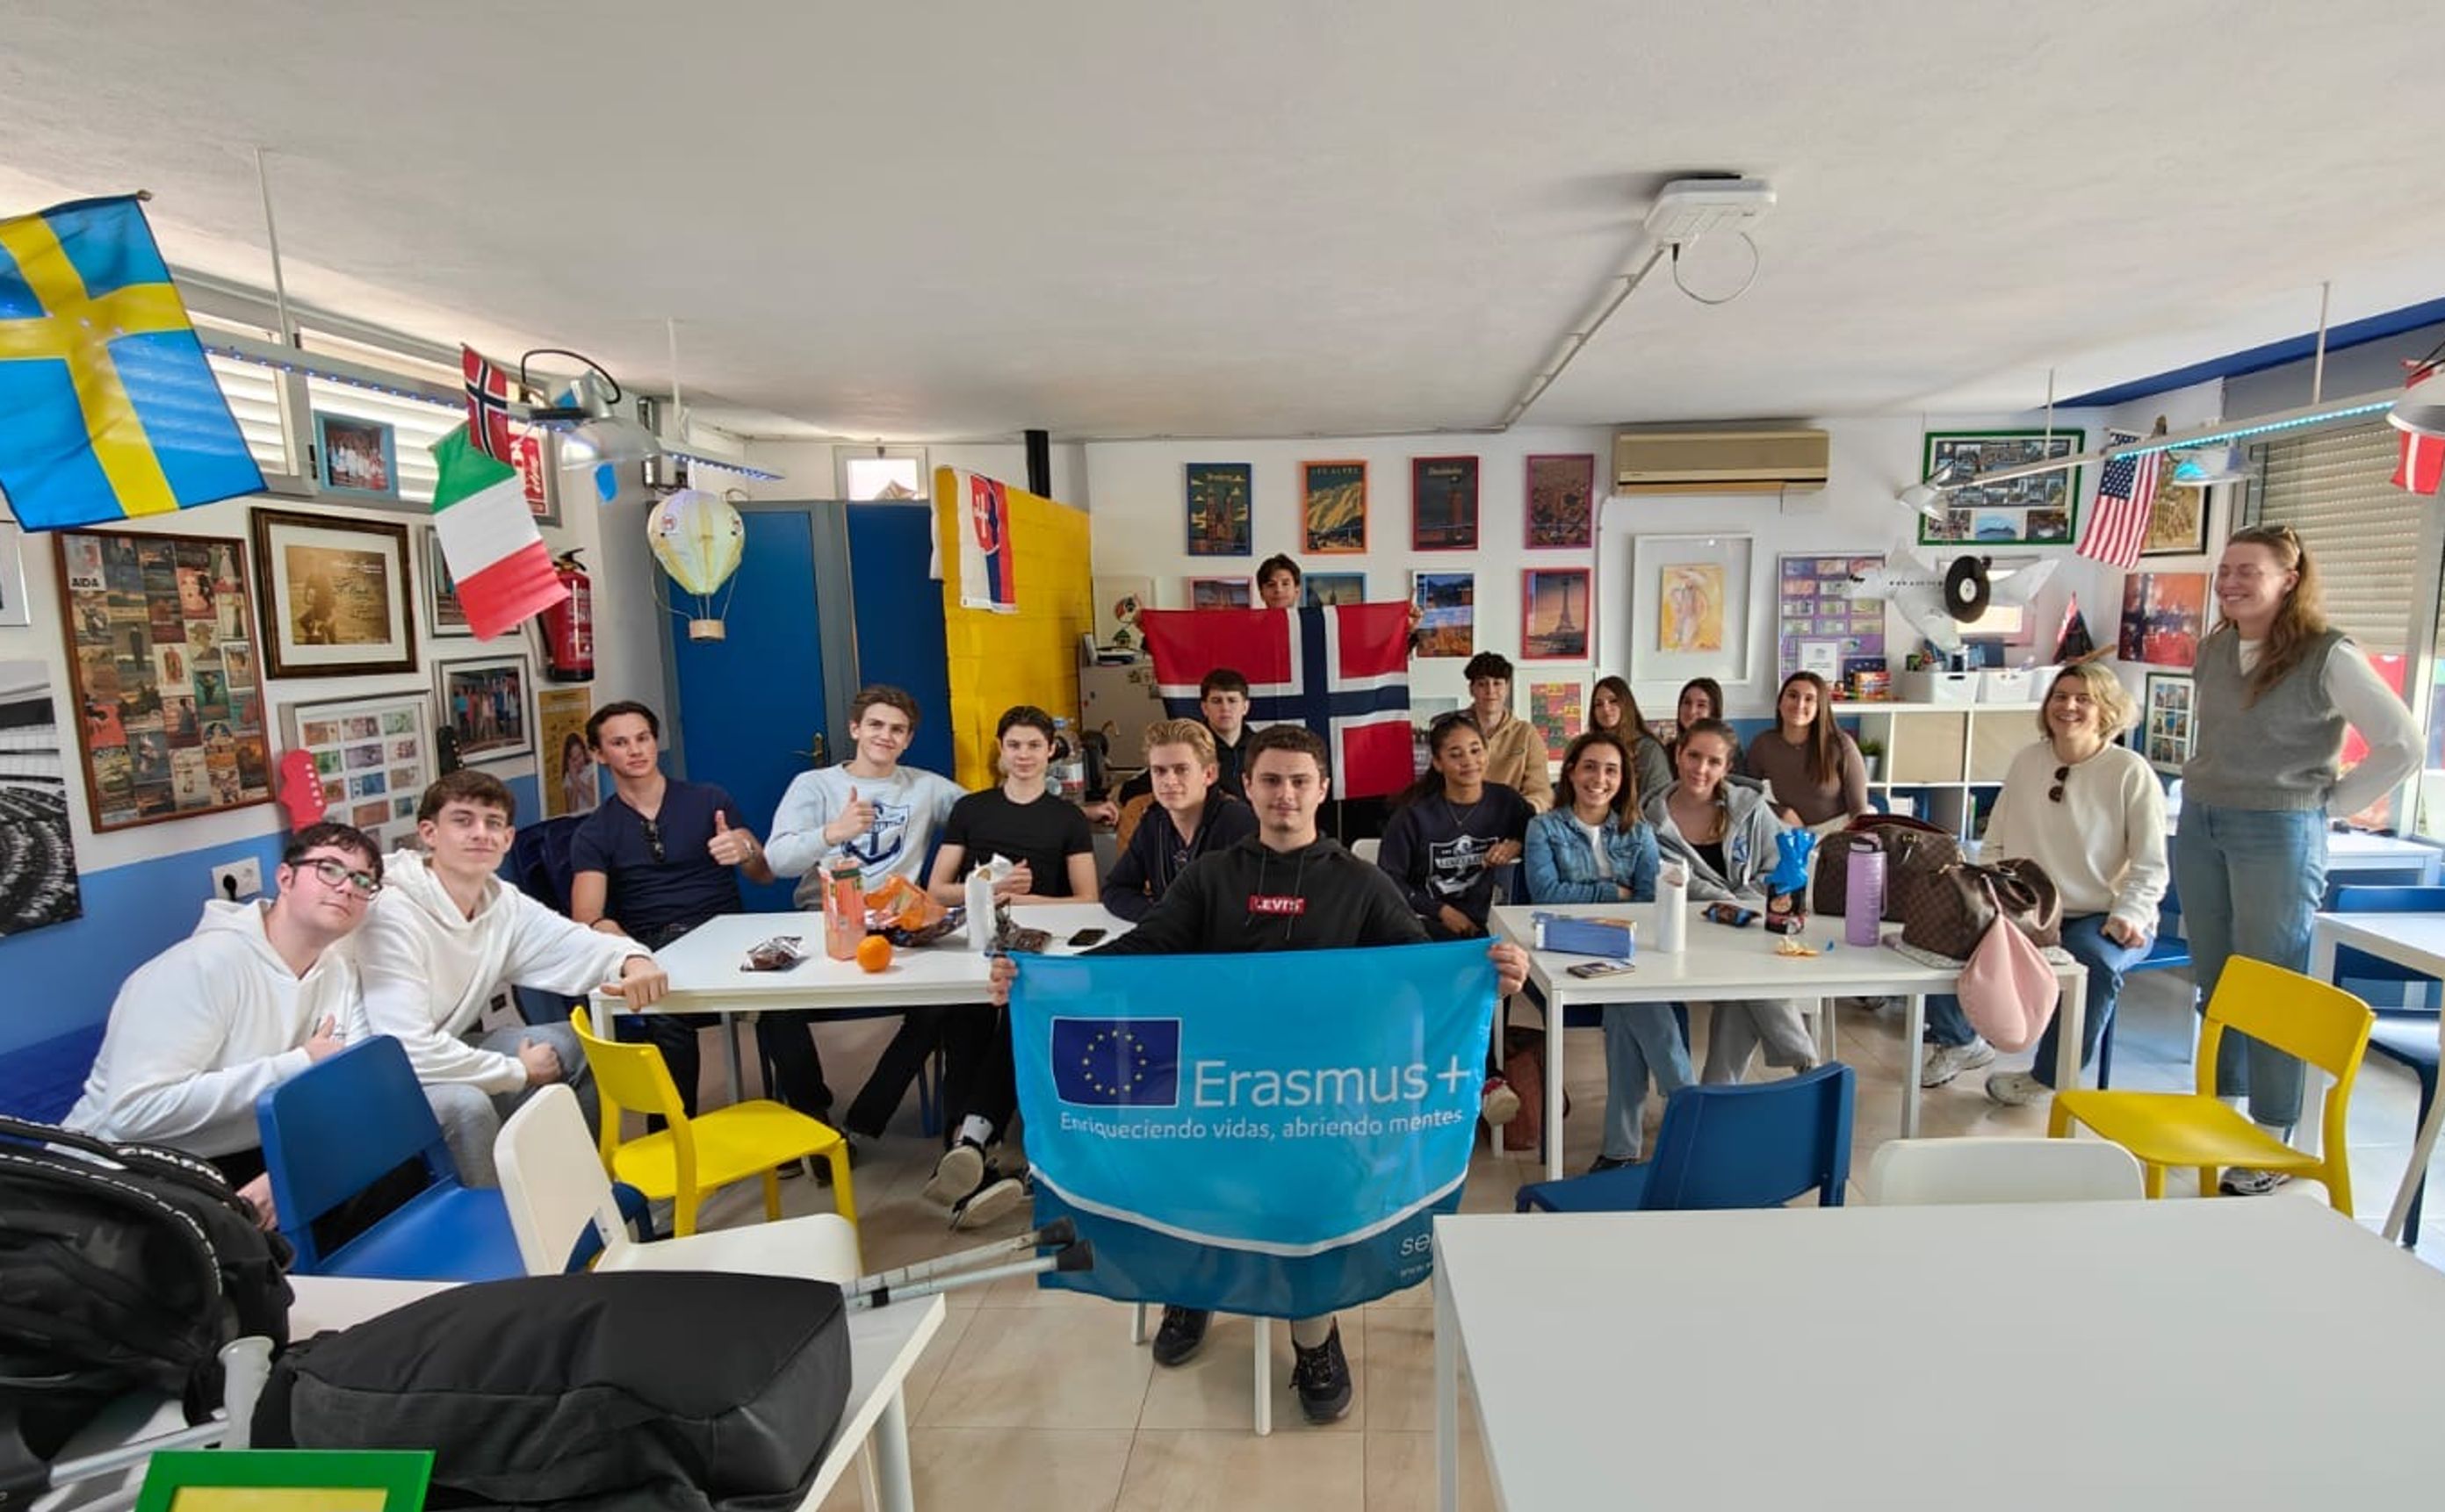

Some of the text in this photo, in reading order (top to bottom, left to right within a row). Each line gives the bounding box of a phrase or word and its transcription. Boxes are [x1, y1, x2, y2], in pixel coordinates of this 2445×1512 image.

[72, 577, 99, 587] AIDA
[1060, 1109, 1463, 1141] Enriqueciendo vidas, abriendo mentes
[1400, 1233, 1433, 1256] se
